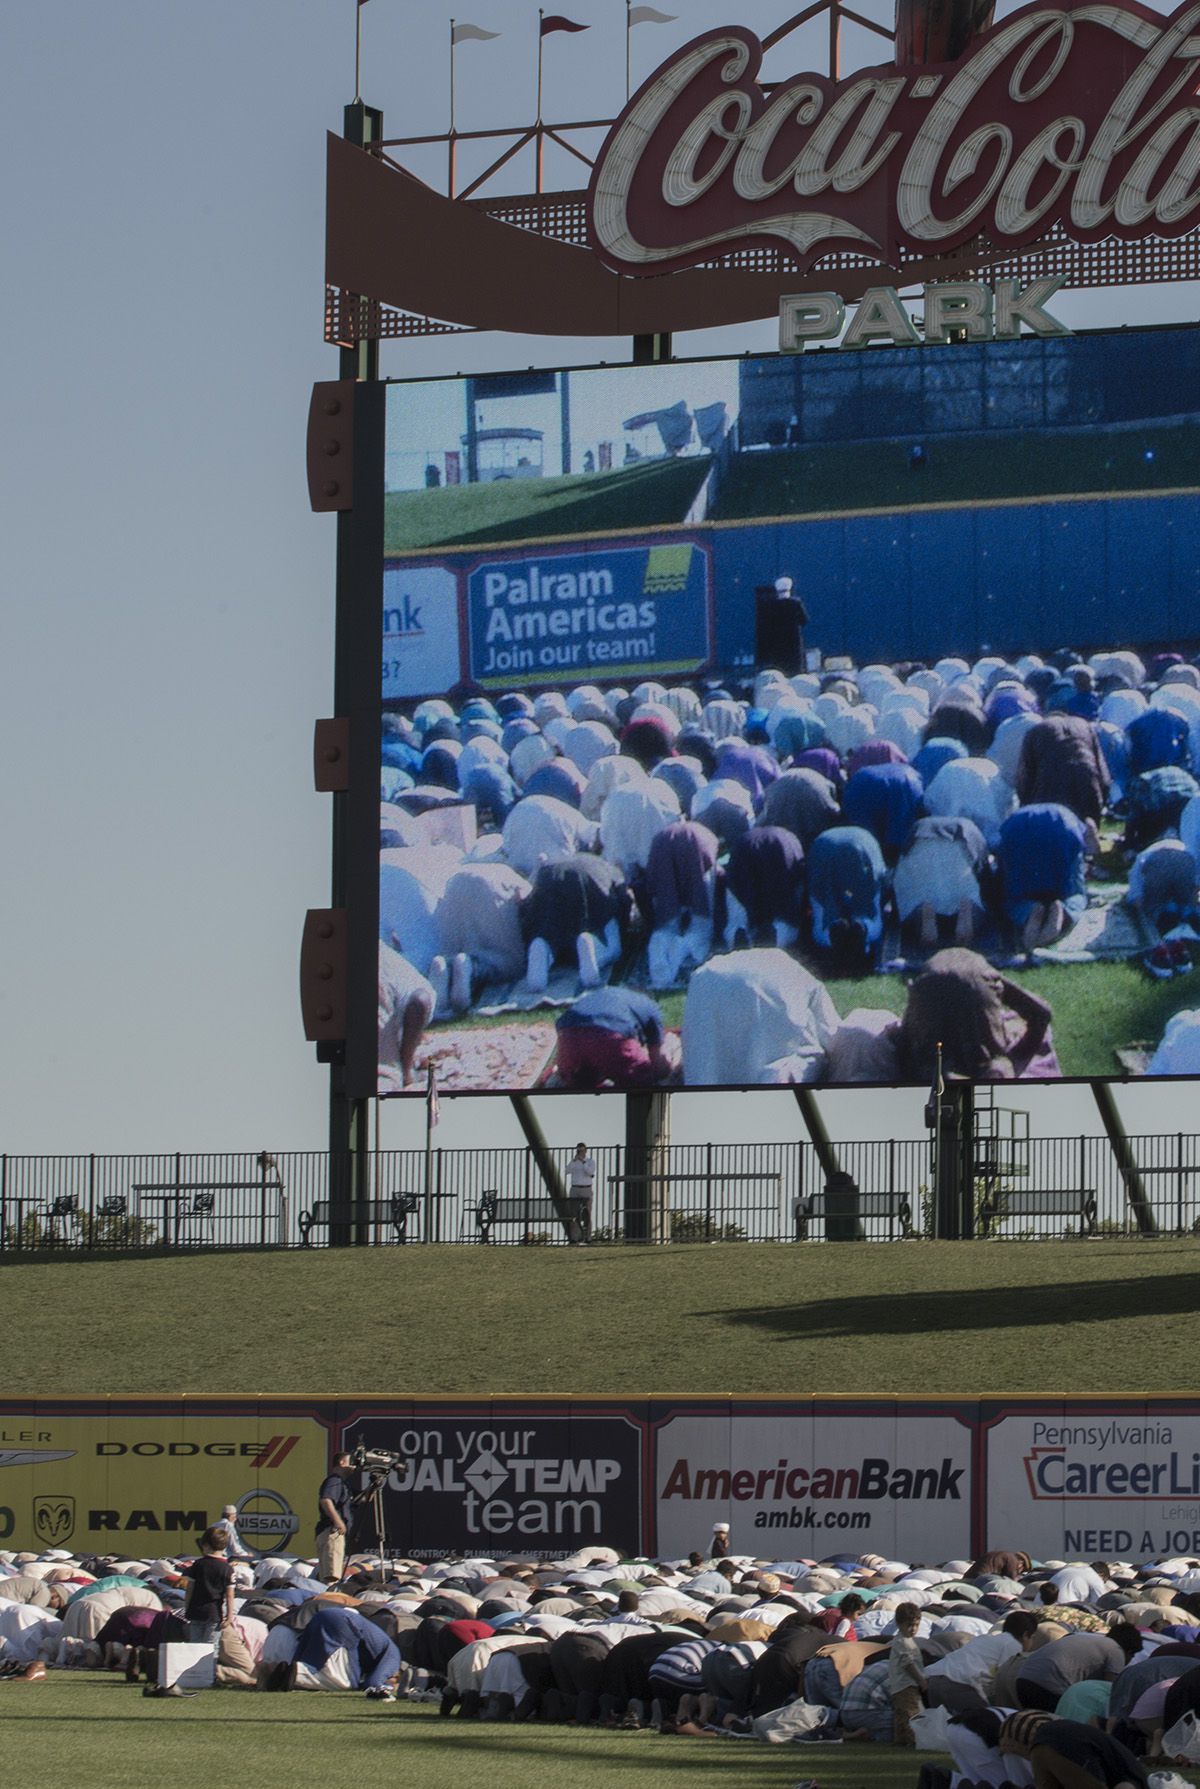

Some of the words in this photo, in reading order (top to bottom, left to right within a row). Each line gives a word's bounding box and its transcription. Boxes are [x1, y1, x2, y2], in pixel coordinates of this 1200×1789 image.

[779, 274, 1075, 354] PARK
[484, 566, 614, 607] Palram
[485, 598, 657, 643] Americas
[483, 648, 534, 672] Join
[540, 644, 581, 664] our
[586, 632, 656, 659] team!
[96, 1442, 270, 1456] DODGE
[400, 1430, 443, 1455] on
[456, 1430, 536, 1463] your
[1032, 1421, 1173, 1451] Pennsylvania
[507, 1459, 622, 1493] TEMP
[661, 1458, 965, 1500] AmericanBank
[88, 1510, 208, 1531] RAM
[237, 1517, 292, 1529] NISSAN
[463, 1490, 602, 1534] team
[754, 1506, 872, 1528] ambk.com
[1064, 1530, 1132, 1553] NEED
[1141, 1530, 1156, 1552] A
